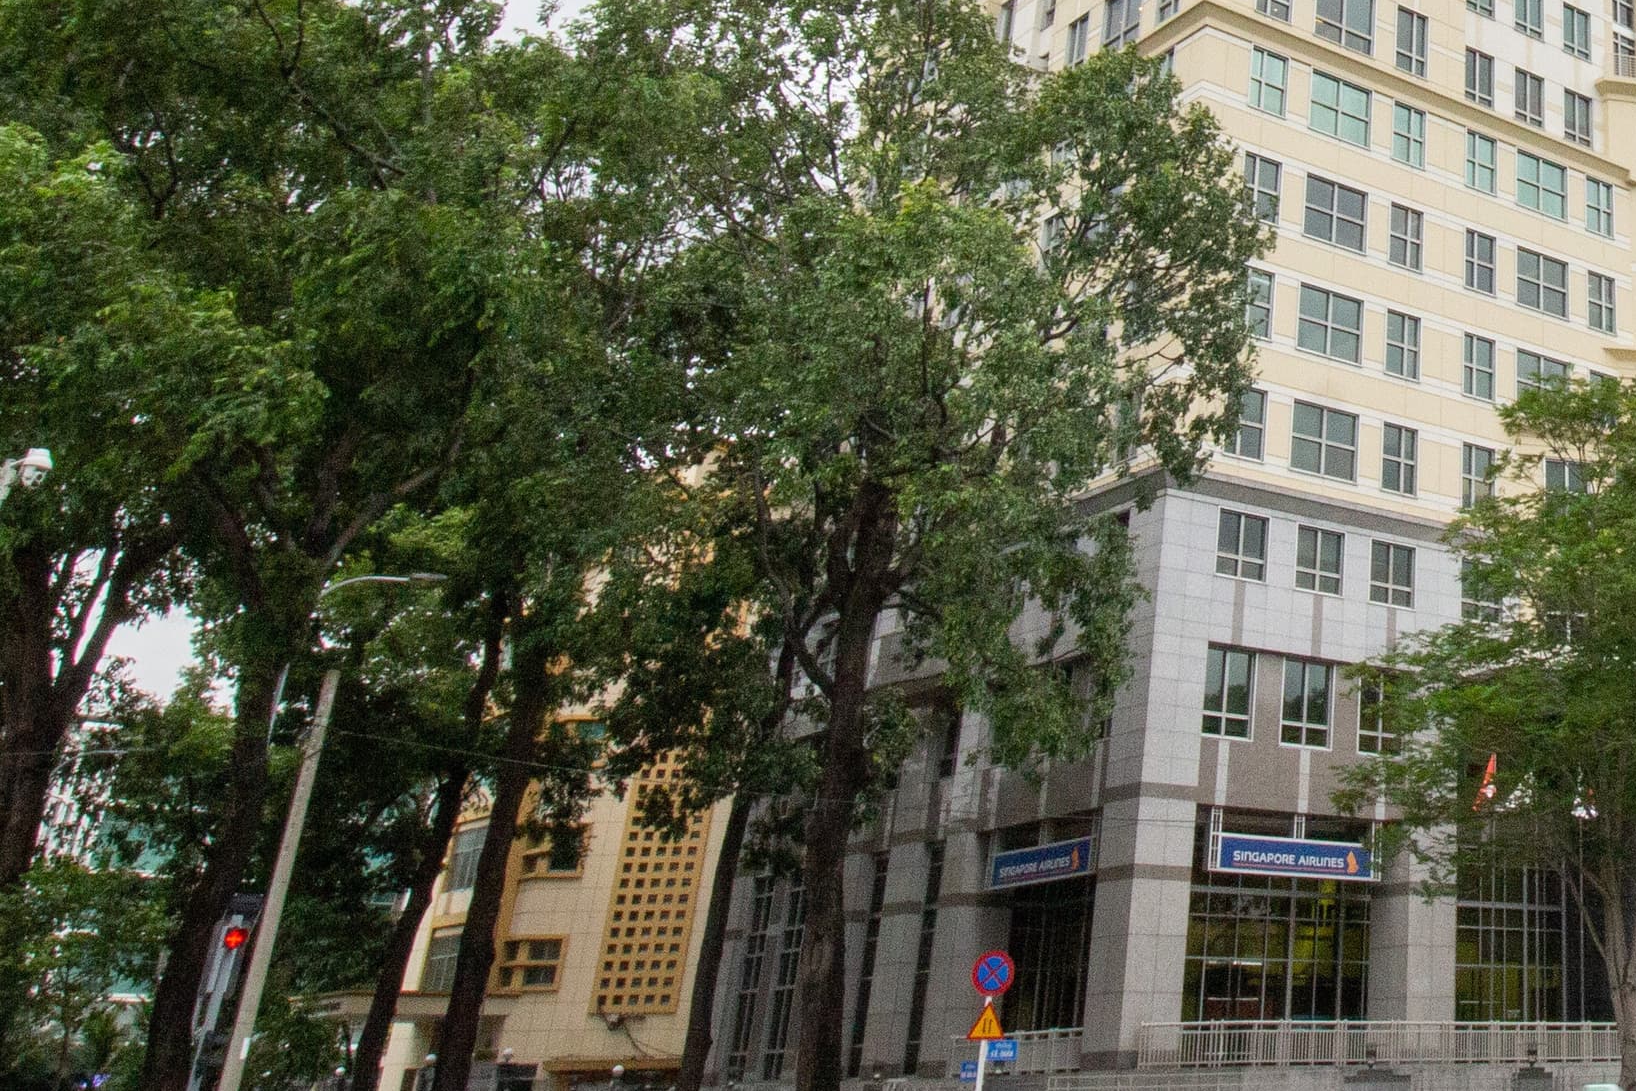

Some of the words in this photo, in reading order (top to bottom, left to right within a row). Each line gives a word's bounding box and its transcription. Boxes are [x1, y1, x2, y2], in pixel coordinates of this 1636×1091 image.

[1038, 856, 1071, 870] AIRLINES
[1232, 850, 1296, 865] SINGAPORE
[1298, 855, 1345, 869] AIRLINES
